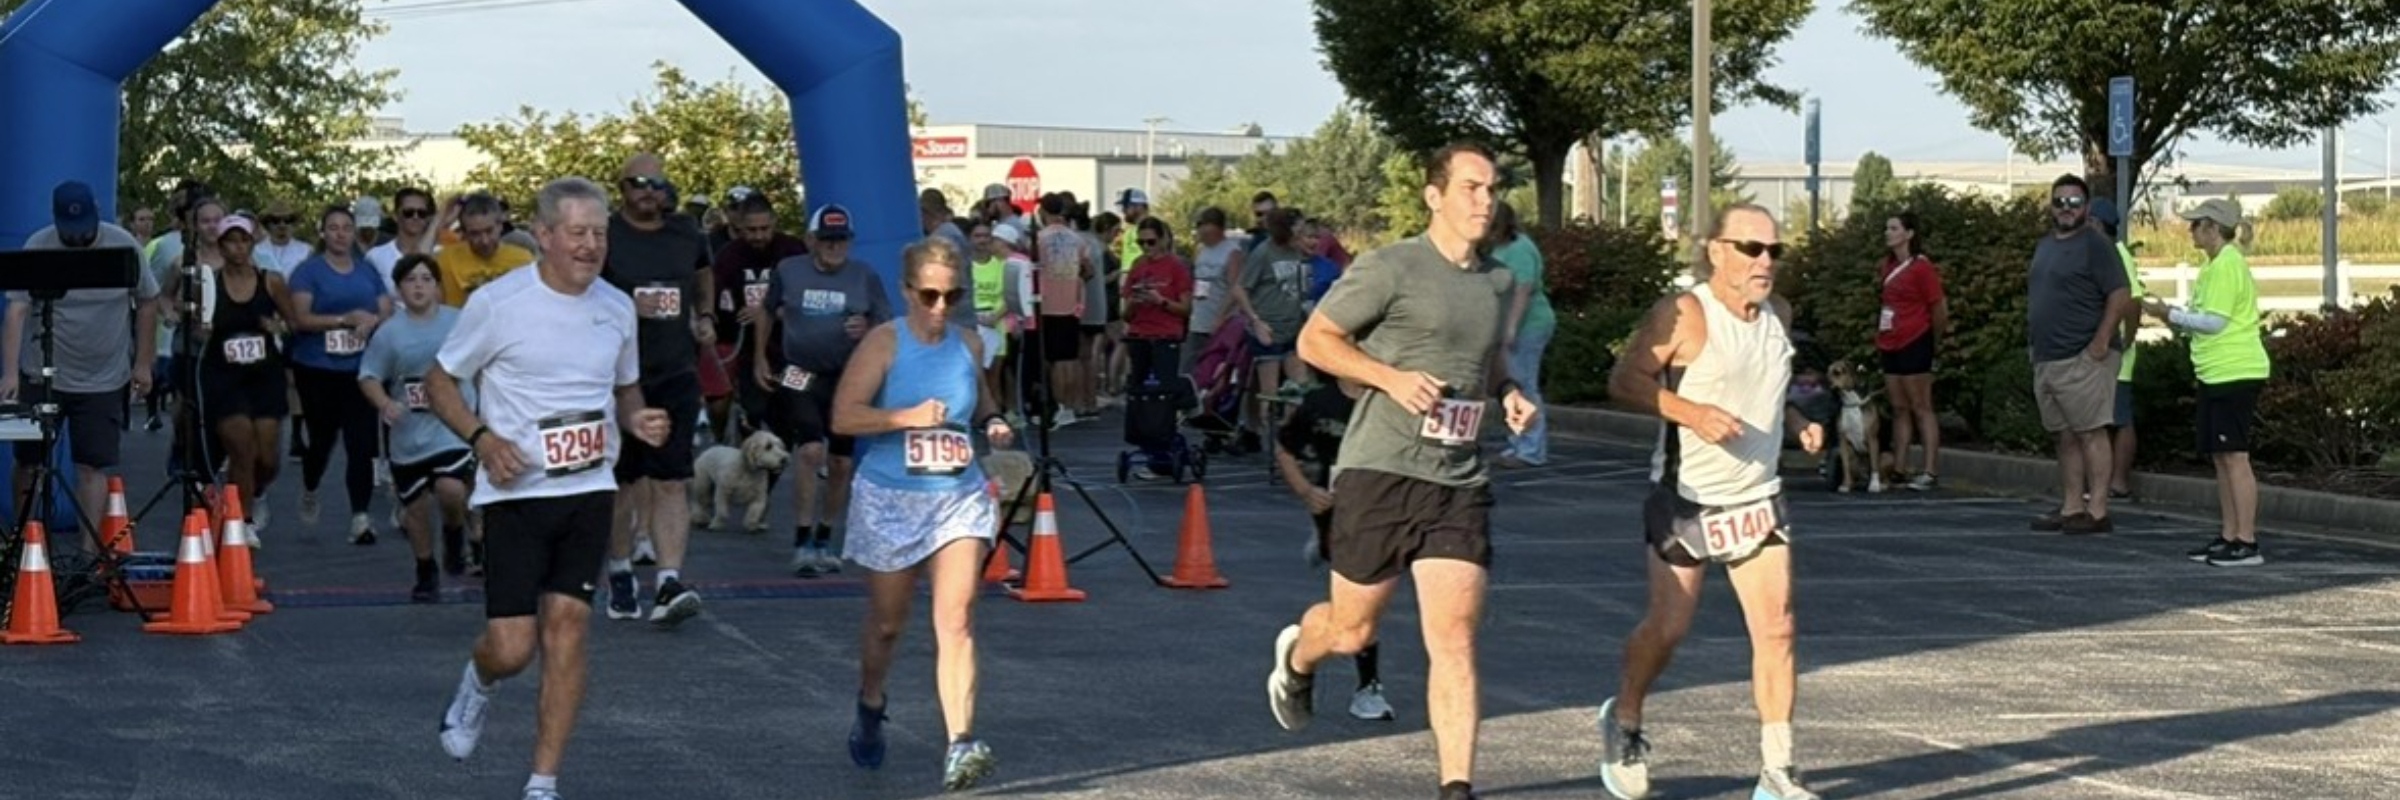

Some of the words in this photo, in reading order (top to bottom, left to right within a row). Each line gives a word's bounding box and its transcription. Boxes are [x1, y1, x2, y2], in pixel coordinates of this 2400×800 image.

[1008, 177, 1039, 201] STOP
[227, 340, 263, 361] 5121
[1427, 402, 1482, 438] 5191
[544, 424, 604, 464] 5294
[909, 432, 970, 464] 5196
[1707, 507, 1770, 550] 5140
